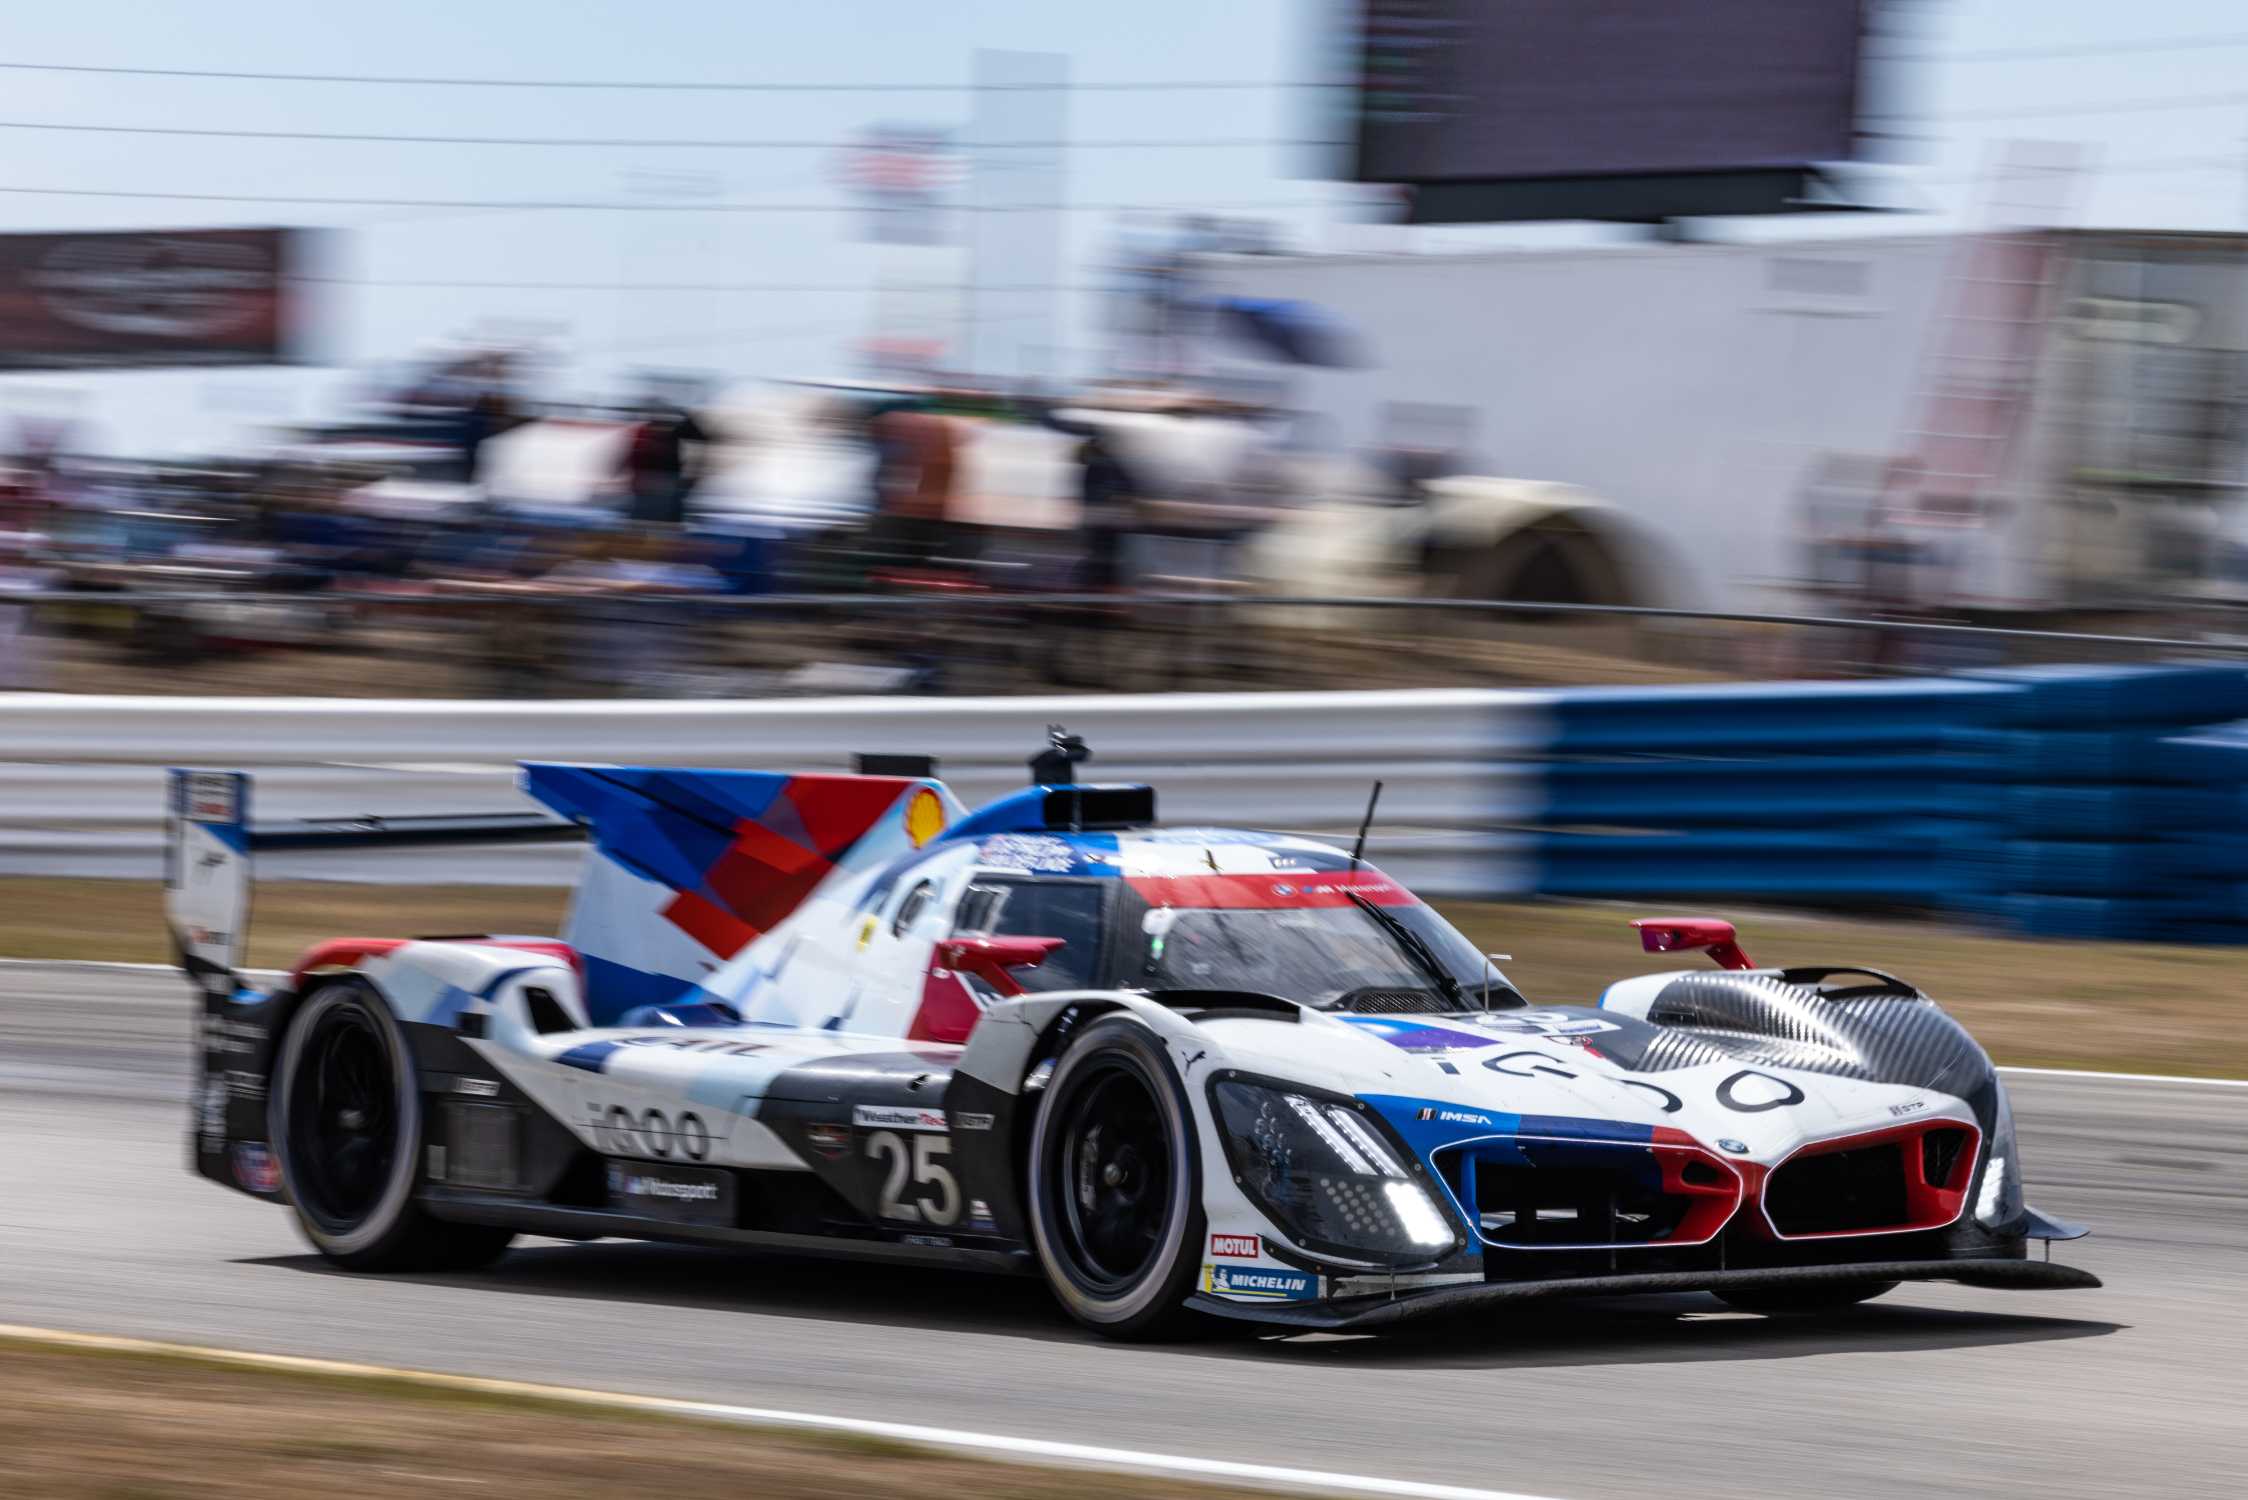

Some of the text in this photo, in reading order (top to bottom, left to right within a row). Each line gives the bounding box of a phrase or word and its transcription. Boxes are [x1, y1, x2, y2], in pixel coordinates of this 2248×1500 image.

[859, 1109, 948, 1126] WeatherTec
[1440, 1111, 1492, 1125] IMSA
[864, 1130, 961, 1226] 25
[1213, 1237, 1256, 1256] MOTUL
[1231, 1274, 1307, 1291] MICHELIN
